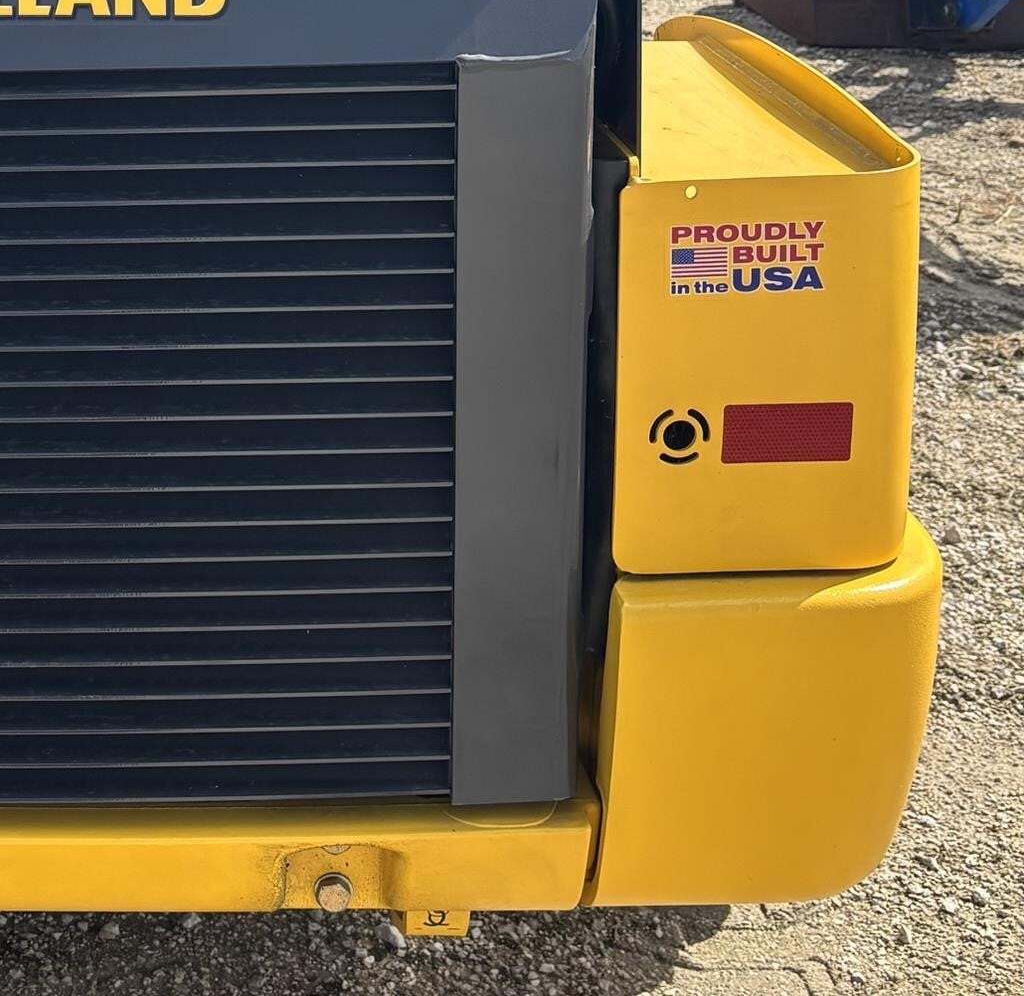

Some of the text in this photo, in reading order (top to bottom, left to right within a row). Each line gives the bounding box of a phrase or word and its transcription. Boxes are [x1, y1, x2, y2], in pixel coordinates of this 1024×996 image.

[671, 220, 824, 245] PROUDLY
[732, 243, 824, 264] BUILT
[670, 266, 824, 295] in the USA
